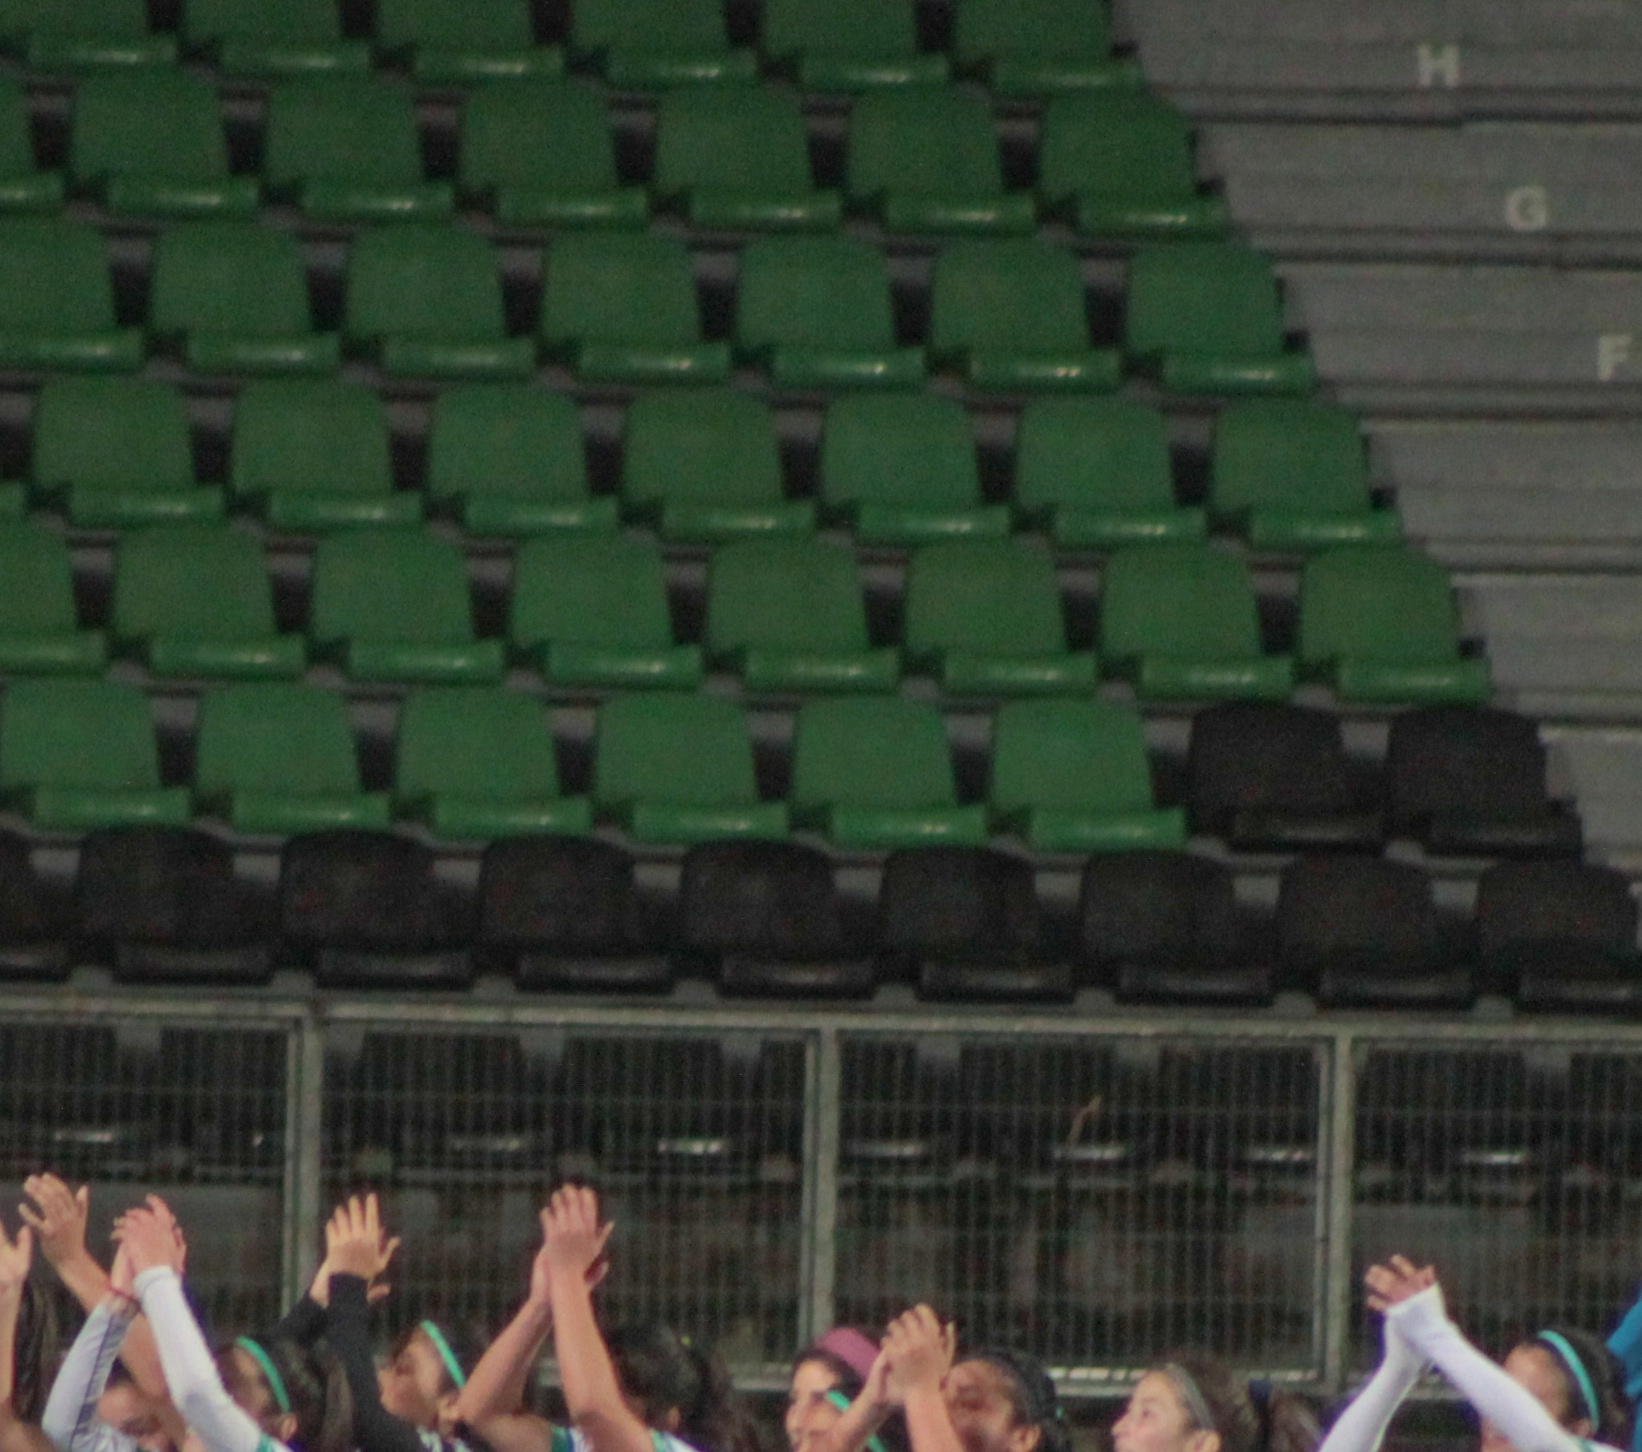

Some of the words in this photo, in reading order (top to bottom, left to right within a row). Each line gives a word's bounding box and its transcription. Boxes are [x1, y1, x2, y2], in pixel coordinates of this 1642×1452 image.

[1418, 45, 1459, 87] H
[1507, 186, 1547, 231] G
[1598, 334, 1632, 381] F
